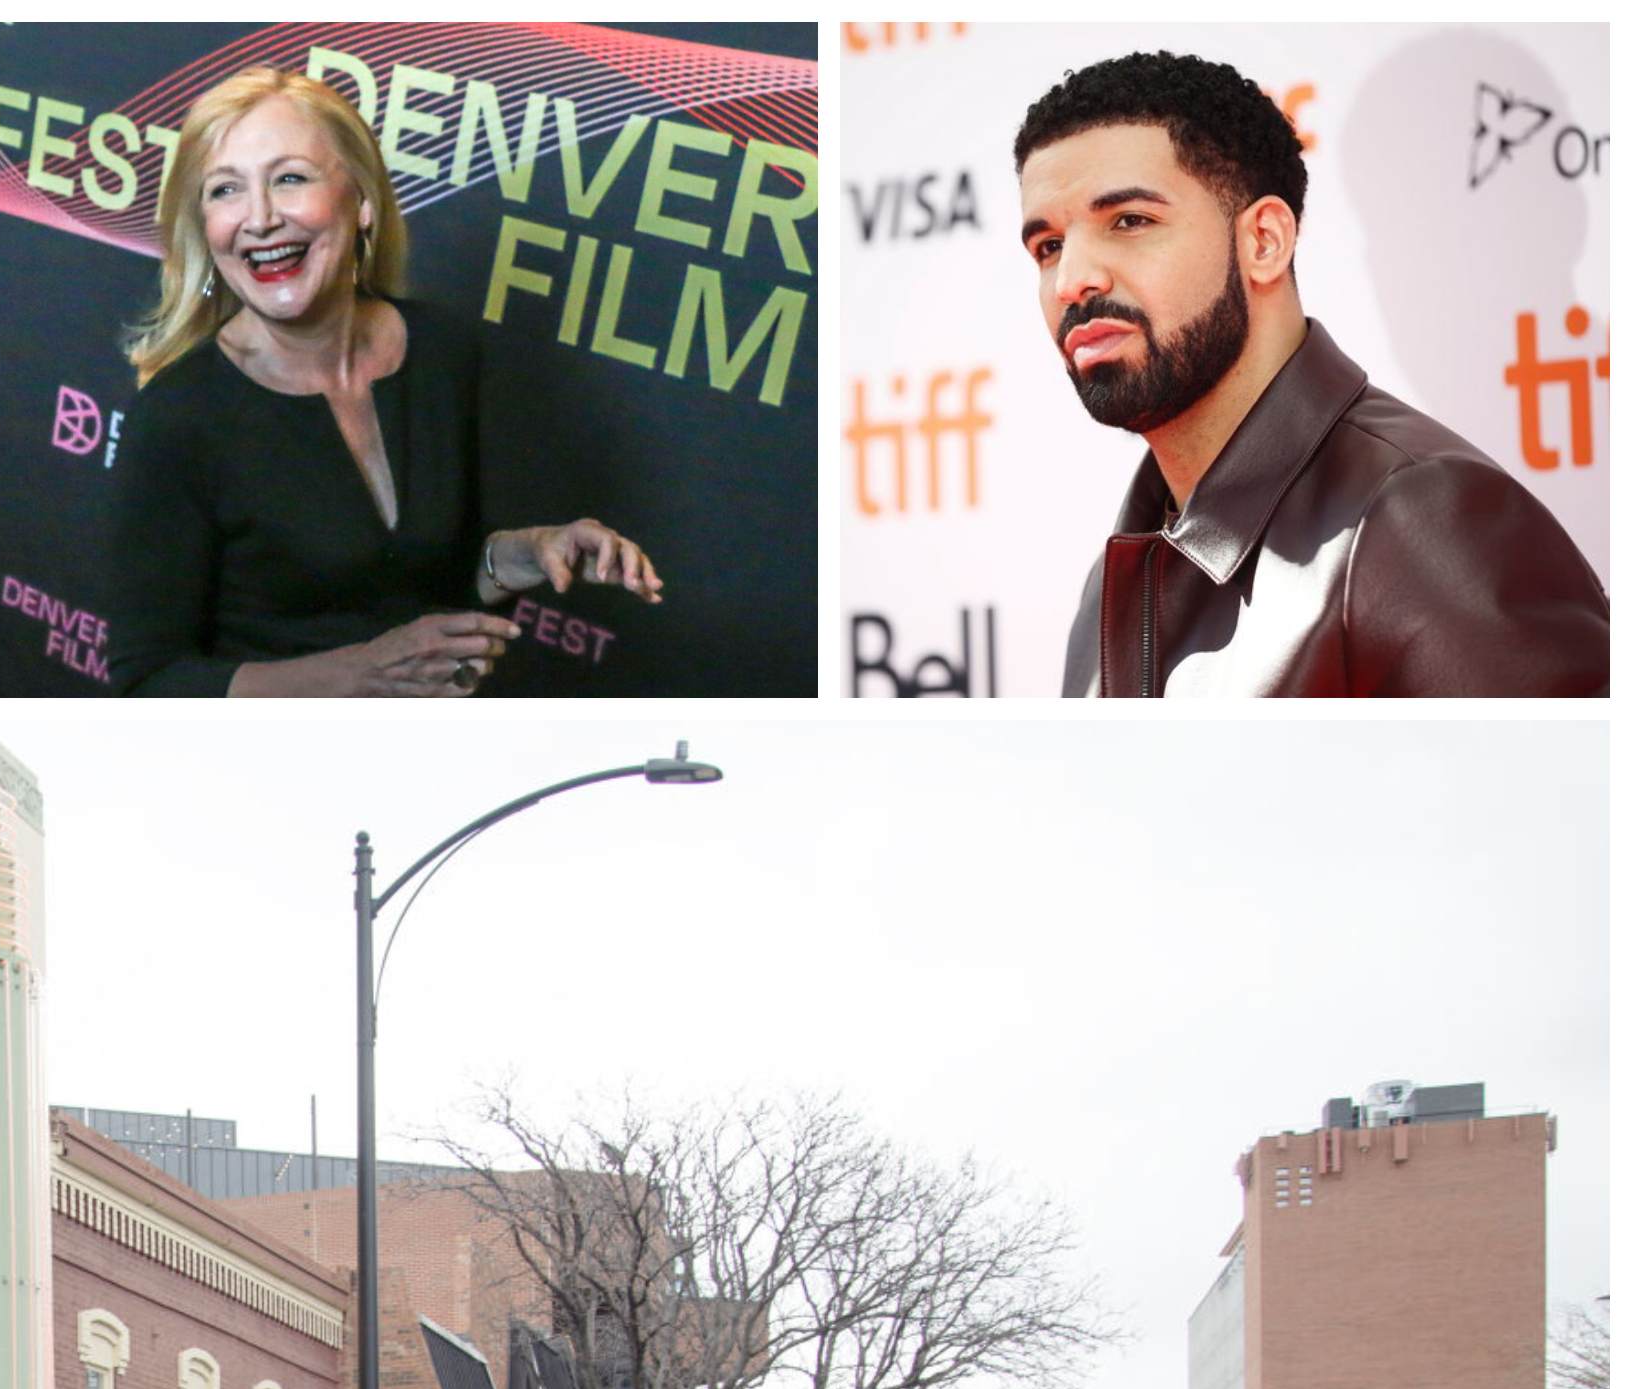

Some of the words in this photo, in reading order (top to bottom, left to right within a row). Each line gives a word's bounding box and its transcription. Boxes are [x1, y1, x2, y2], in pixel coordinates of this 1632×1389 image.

[848, 168, 982, 242] VISA
[482, 215, 808, 407] FILM
[845, 367, 994, 517] tiff
[1504, 304, 1610, 471] ti
[514, 599, 616, 663] FEST
[850, 601, 997, 697] Bell
